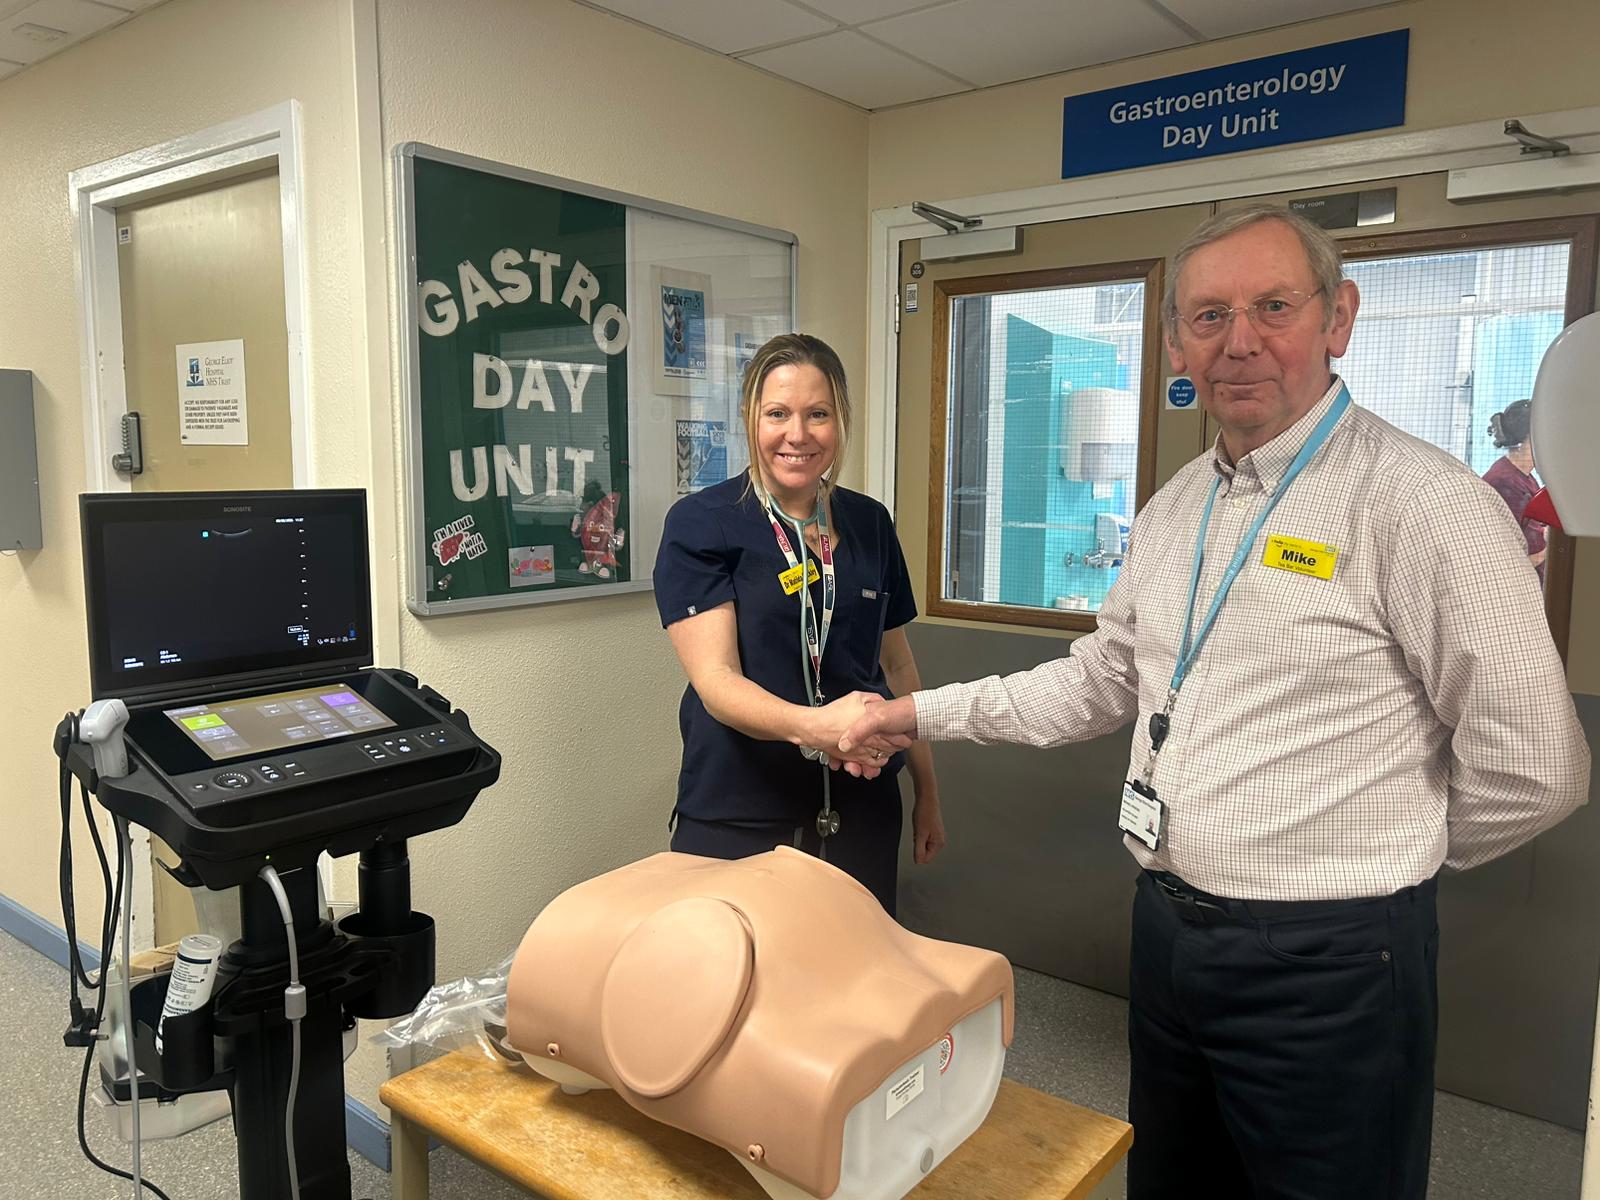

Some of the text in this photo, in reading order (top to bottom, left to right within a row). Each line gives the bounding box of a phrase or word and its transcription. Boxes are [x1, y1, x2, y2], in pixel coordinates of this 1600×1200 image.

[1108, 64, 1346, 124] Gastroenterology
[1162, 108, 1279, 148] Day Unit
[418, 247, 630, 355] GASTRO
[472, 351, 593, 413] DAY
[449, 444, 595, 502] UNIT
[435, 529, 447, 542] I'M
[453, 516, 474, 532] LIVER
[464, 536, 476, 549] NOT
[467, 542, 486, 558] HATER
[1281, 549, 1316, 566] Mike
